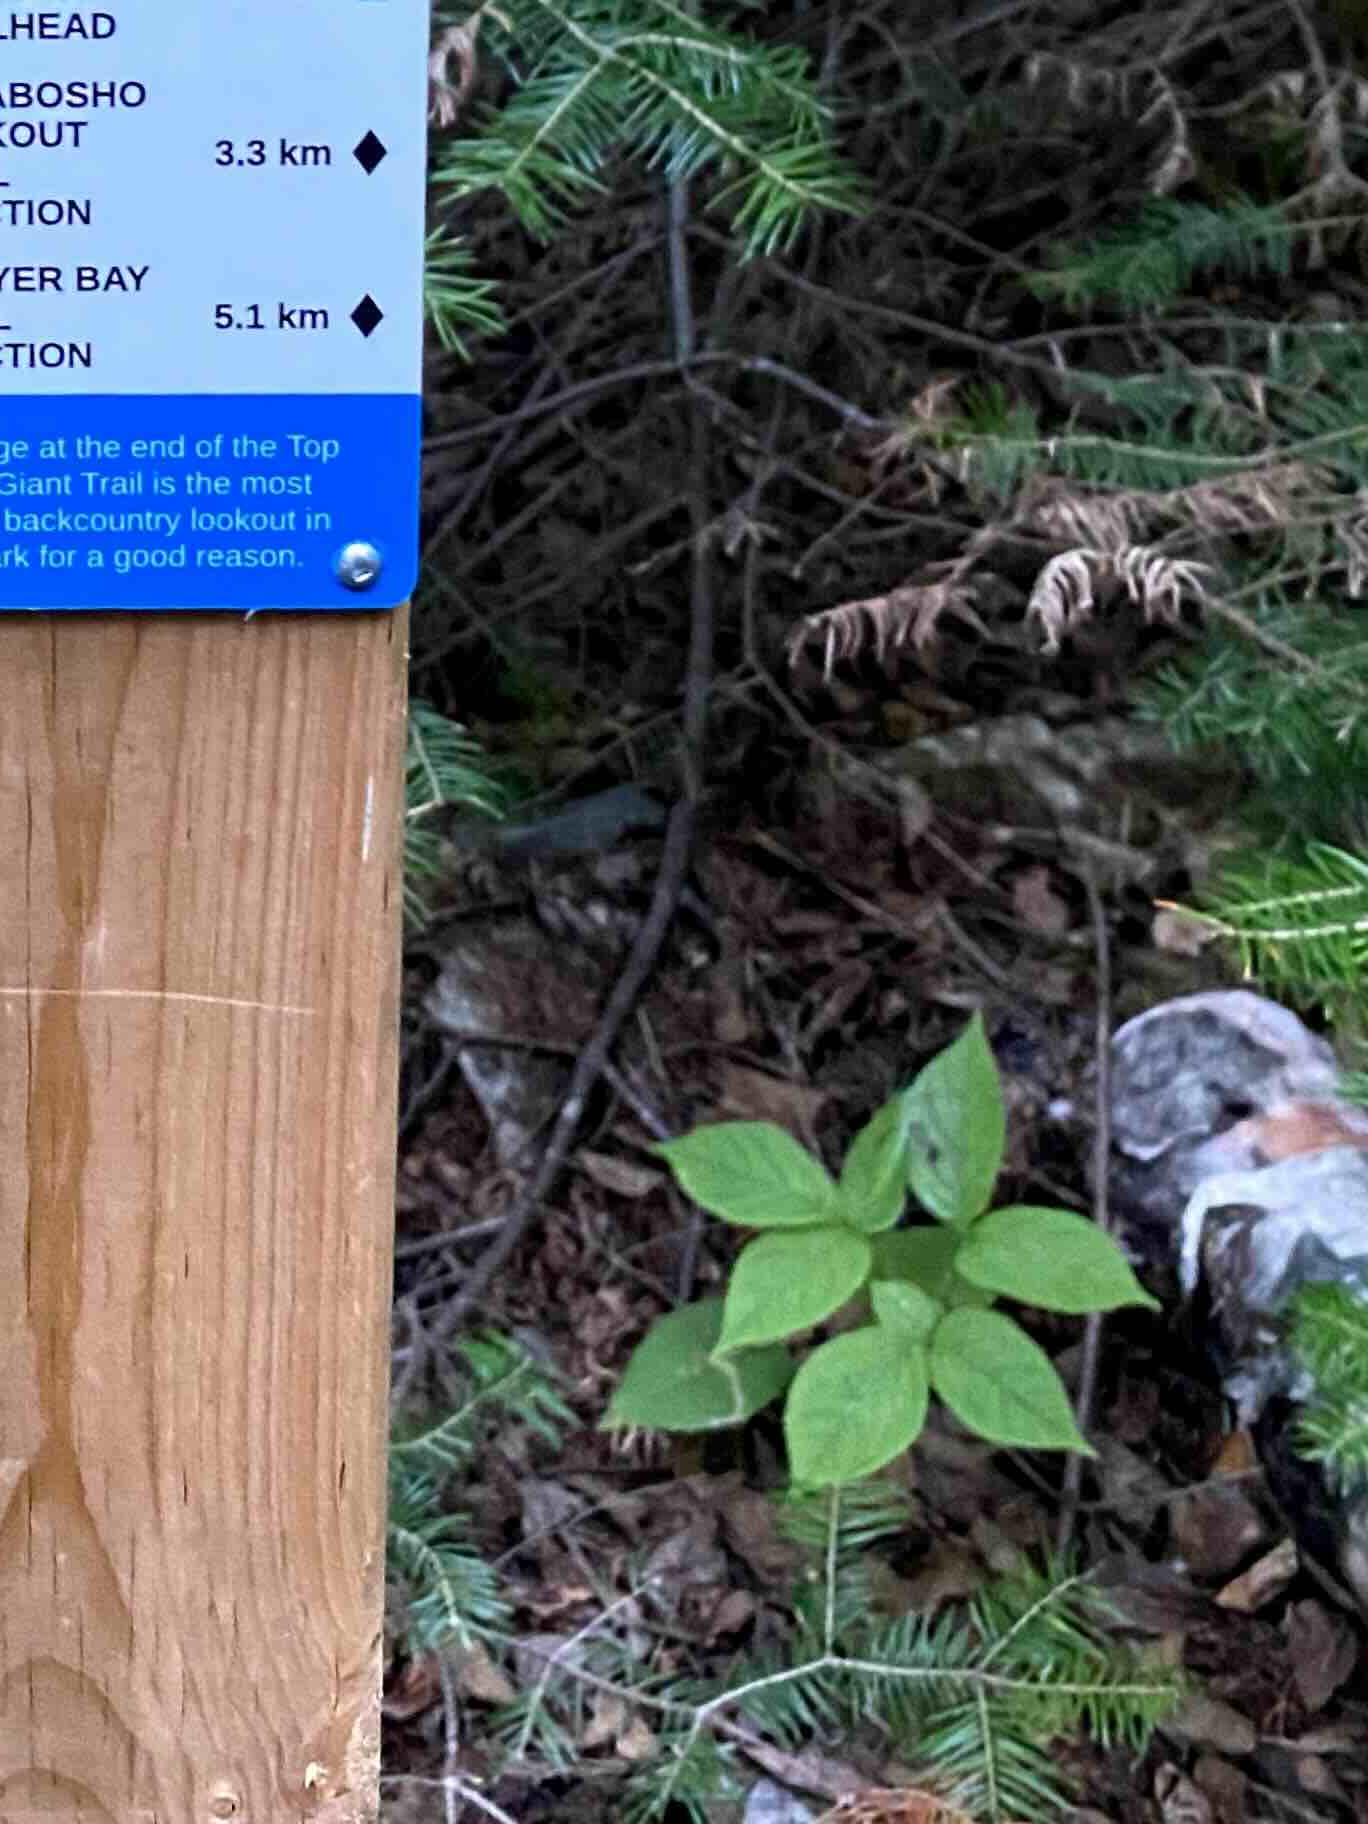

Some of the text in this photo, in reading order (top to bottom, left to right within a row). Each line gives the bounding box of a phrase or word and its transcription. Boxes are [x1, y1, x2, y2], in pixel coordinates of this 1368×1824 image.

[216, 137, 331, 166] 3.3 km
[76, 266, 149, 291] BAY
[215, 301, 329, 329] 5.1 km
[40, 439, 66, 458] at
[77, 435, 120, 458] the
[131, 435, 184, 458] end
[196, 434, 222, 457] of
[233, 435, 277, 457] the
[288, 435, 339, 463] Top
[80, 472, 142, 495] Trail
[154, 472, 175, 495] is
[186, 472, 230, 494] the
[242, 475, 312, 495] most
[5, 509, 180, 536] backcountry
[192, 508, 295, 530] lookout
[307, 508, 330, 530] in
[40, 544, 76, 567] for
[88, 550, 104, 568] a
[114, 544, 185, 573] good
[197, 549, 303, 567] reason.
